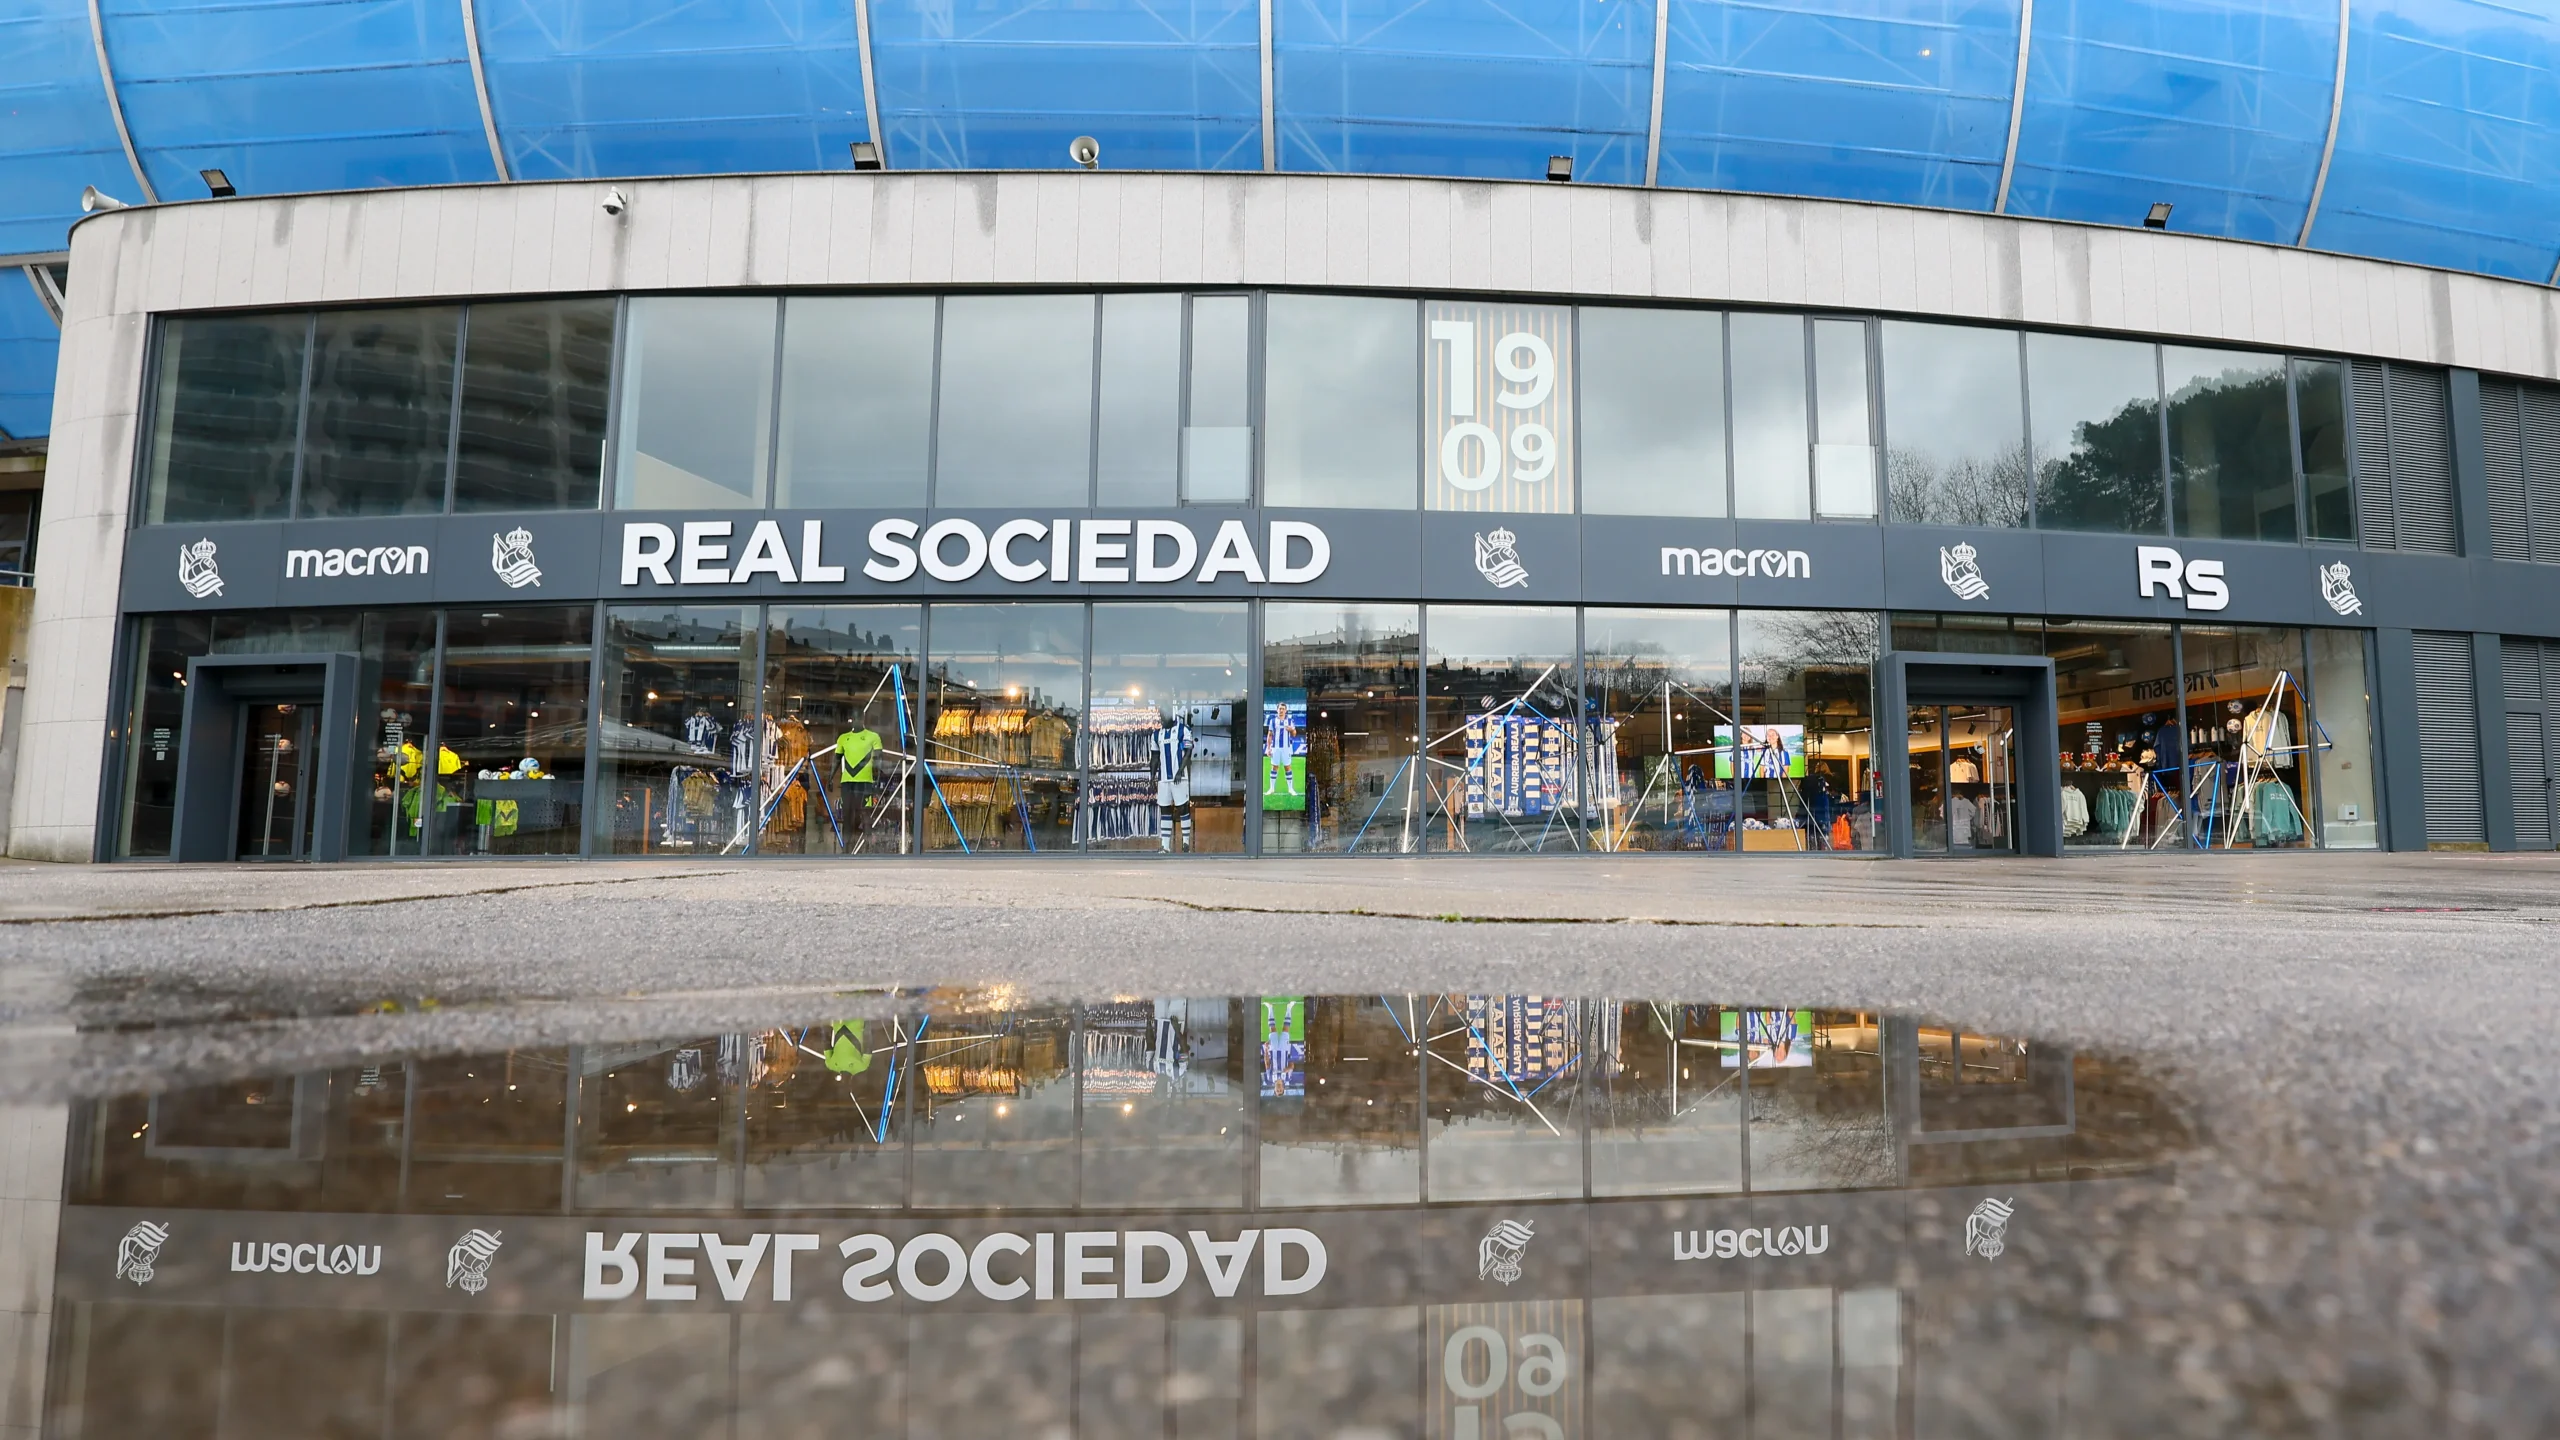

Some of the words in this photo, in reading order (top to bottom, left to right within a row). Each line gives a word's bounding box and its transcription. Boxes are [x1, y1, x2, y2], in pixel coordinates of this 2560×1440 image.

[1432, 320, 1554, 416] 19
[1441, 422, 1556, 491] 09
[286, 545, 428, 578] macron
[620, 520, 845, 585] REAL
[863, 518, 1331, 583] SOCIEDAD
[1661, 546, 1811, 579] macron
[2132, 674, 2204, 700] macon
[1511, 723, 1519, 751] REALA
[1511, 752, 1520, 796] AURRERA
